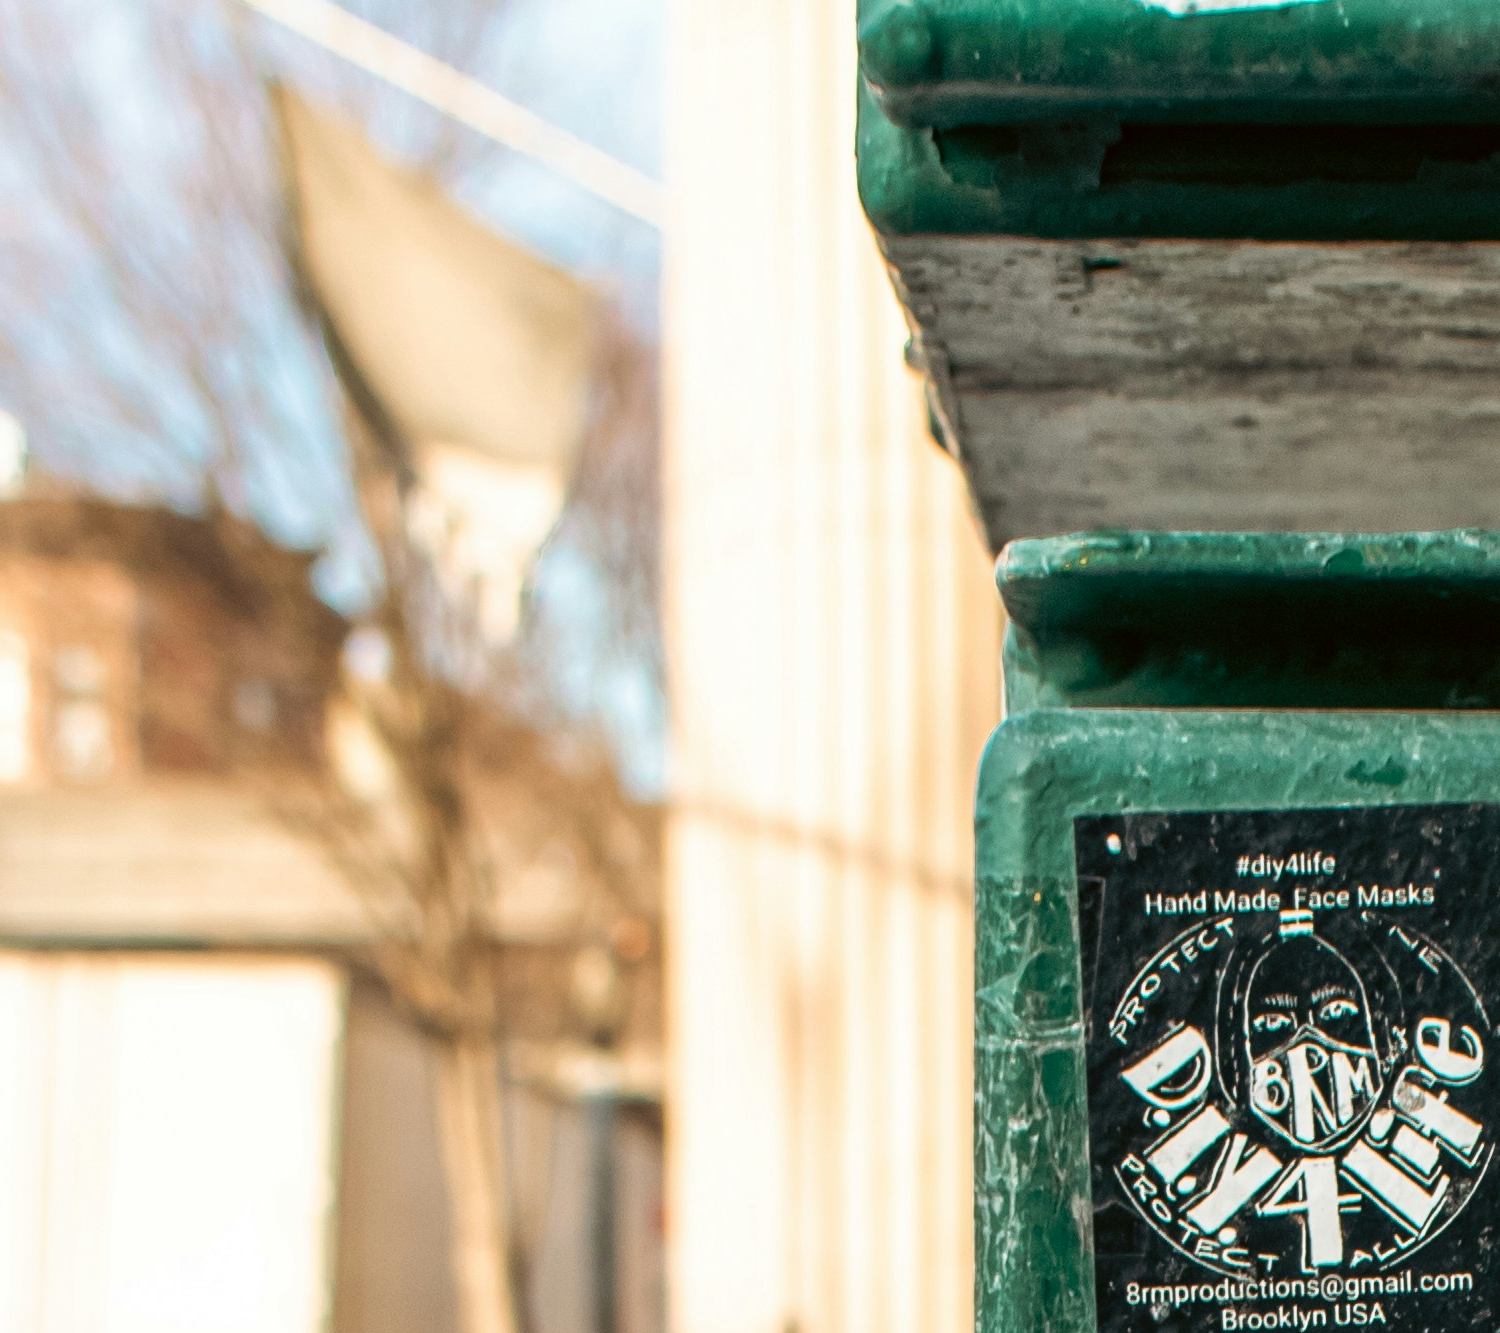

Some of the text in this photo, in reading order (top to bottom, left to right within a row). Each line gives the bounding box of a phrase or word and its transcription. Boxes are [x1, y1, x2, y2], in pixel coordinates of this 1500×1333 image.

[1236, 851, 1336, 882] #diy4life
[1144, 883, 1436, 915] Hand Made Face Masks
[1221, 1302, 1387, 1333] Brooklyn USA
